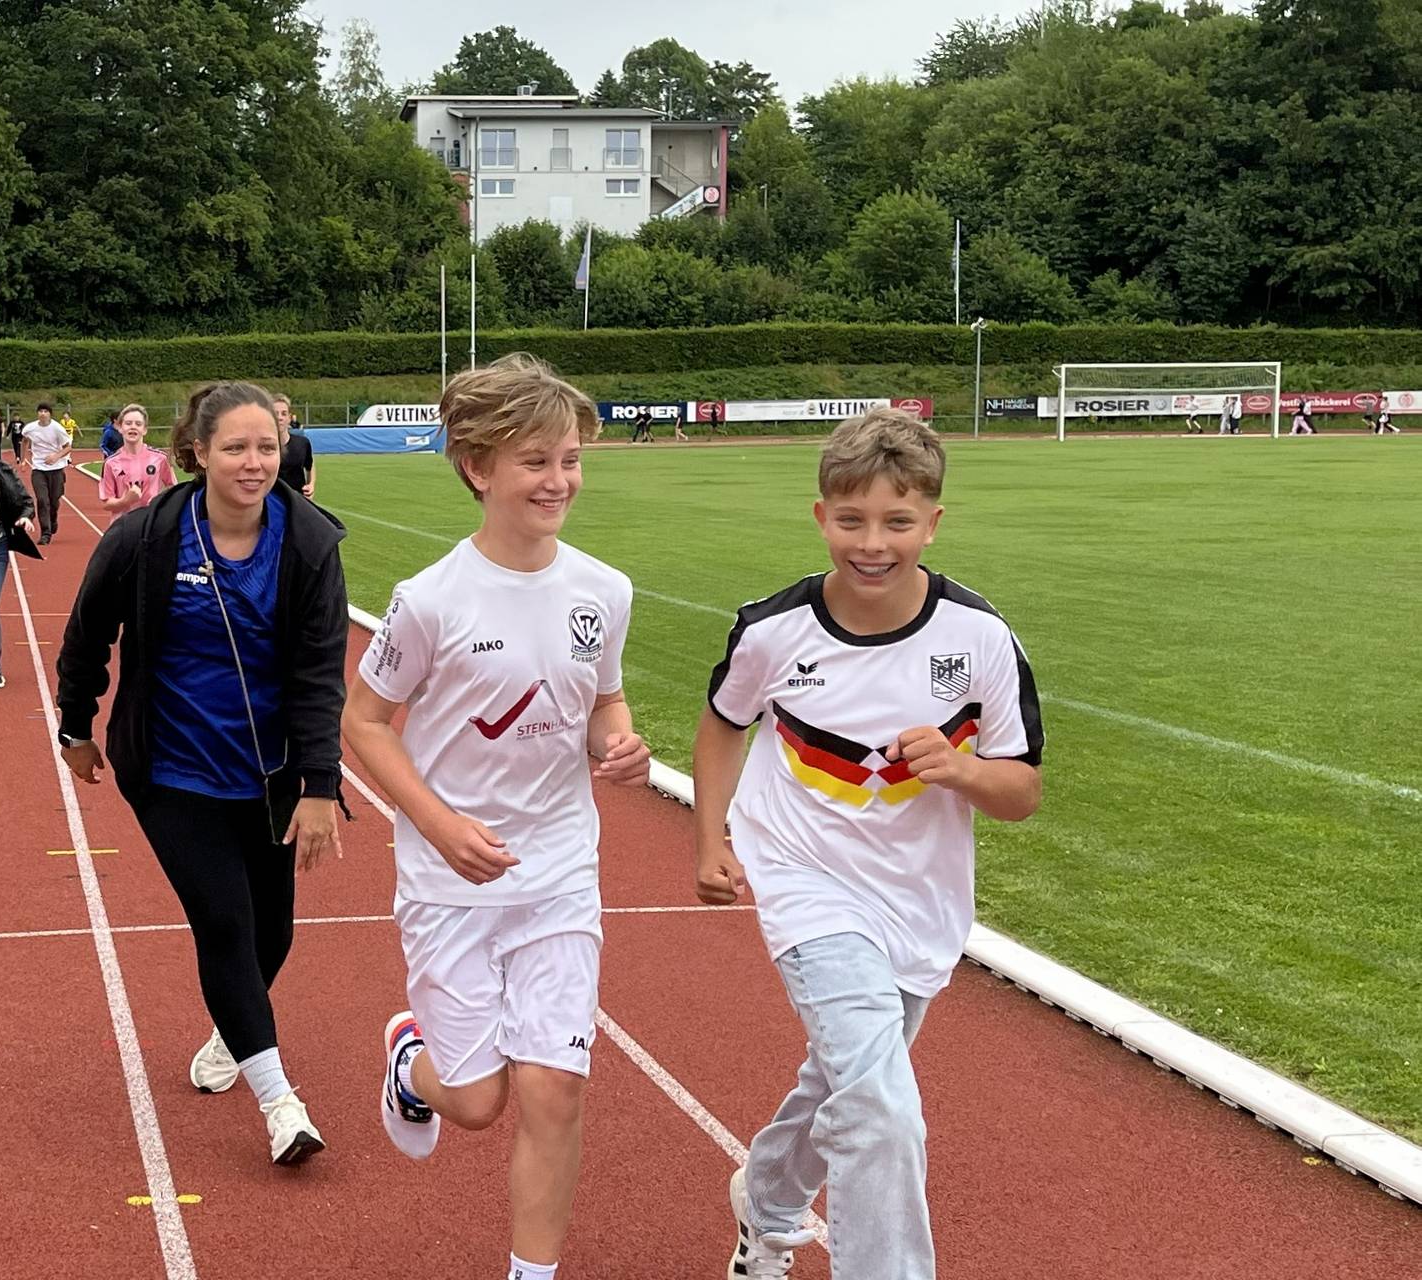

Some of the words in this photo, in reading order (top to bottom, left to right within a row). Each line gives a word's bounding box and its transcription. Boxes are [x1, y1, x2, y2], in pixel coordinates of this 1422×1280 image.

[1075, 400, 1150, 412] ROSIER
[386, 408, 435, 422] VELTINS
[472, 640, 504, 653] JAKO
[788, 677, 825, 686] erima
[569, 1036, 587, 1050] JA
